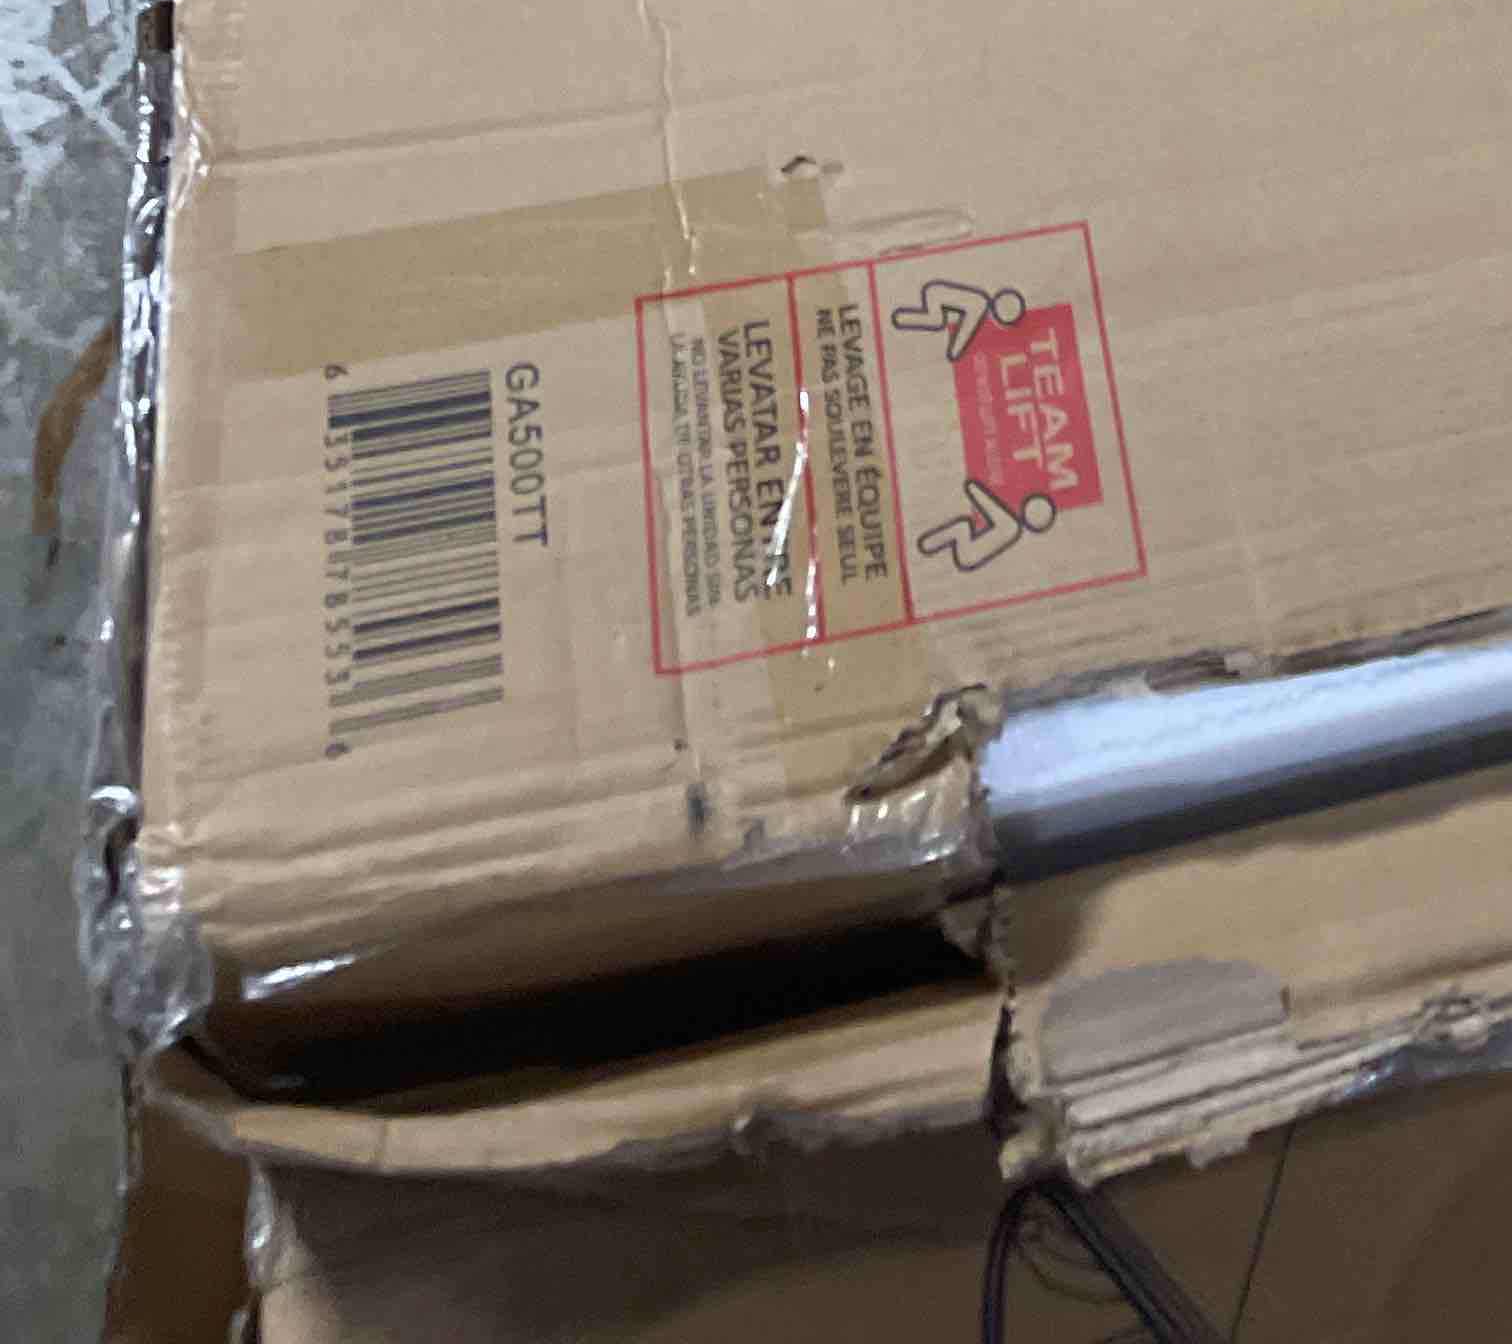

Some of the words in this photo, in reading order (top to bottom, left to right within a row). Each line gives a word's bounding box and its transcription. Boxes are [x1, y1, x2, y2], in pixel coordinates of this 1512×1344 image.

[817, 308, 836, 337] NE
[821, 344, 840, 383] PAS
[838, 304, 870, 411] LEVAGE
[719, 327, 746, 433] VARIAS
[744, 320, 781, 468] LEVATAR
[1001, 354, 1043, 469] LIFT
[1029, 328, 1078, 489] TEAM
[505, 361, 549, 547] GA500TT
[851, 420, 873, 456] EN
[727, 441, 760, 603] PERSONAS
[838, 526, 858, 585] SEUL
